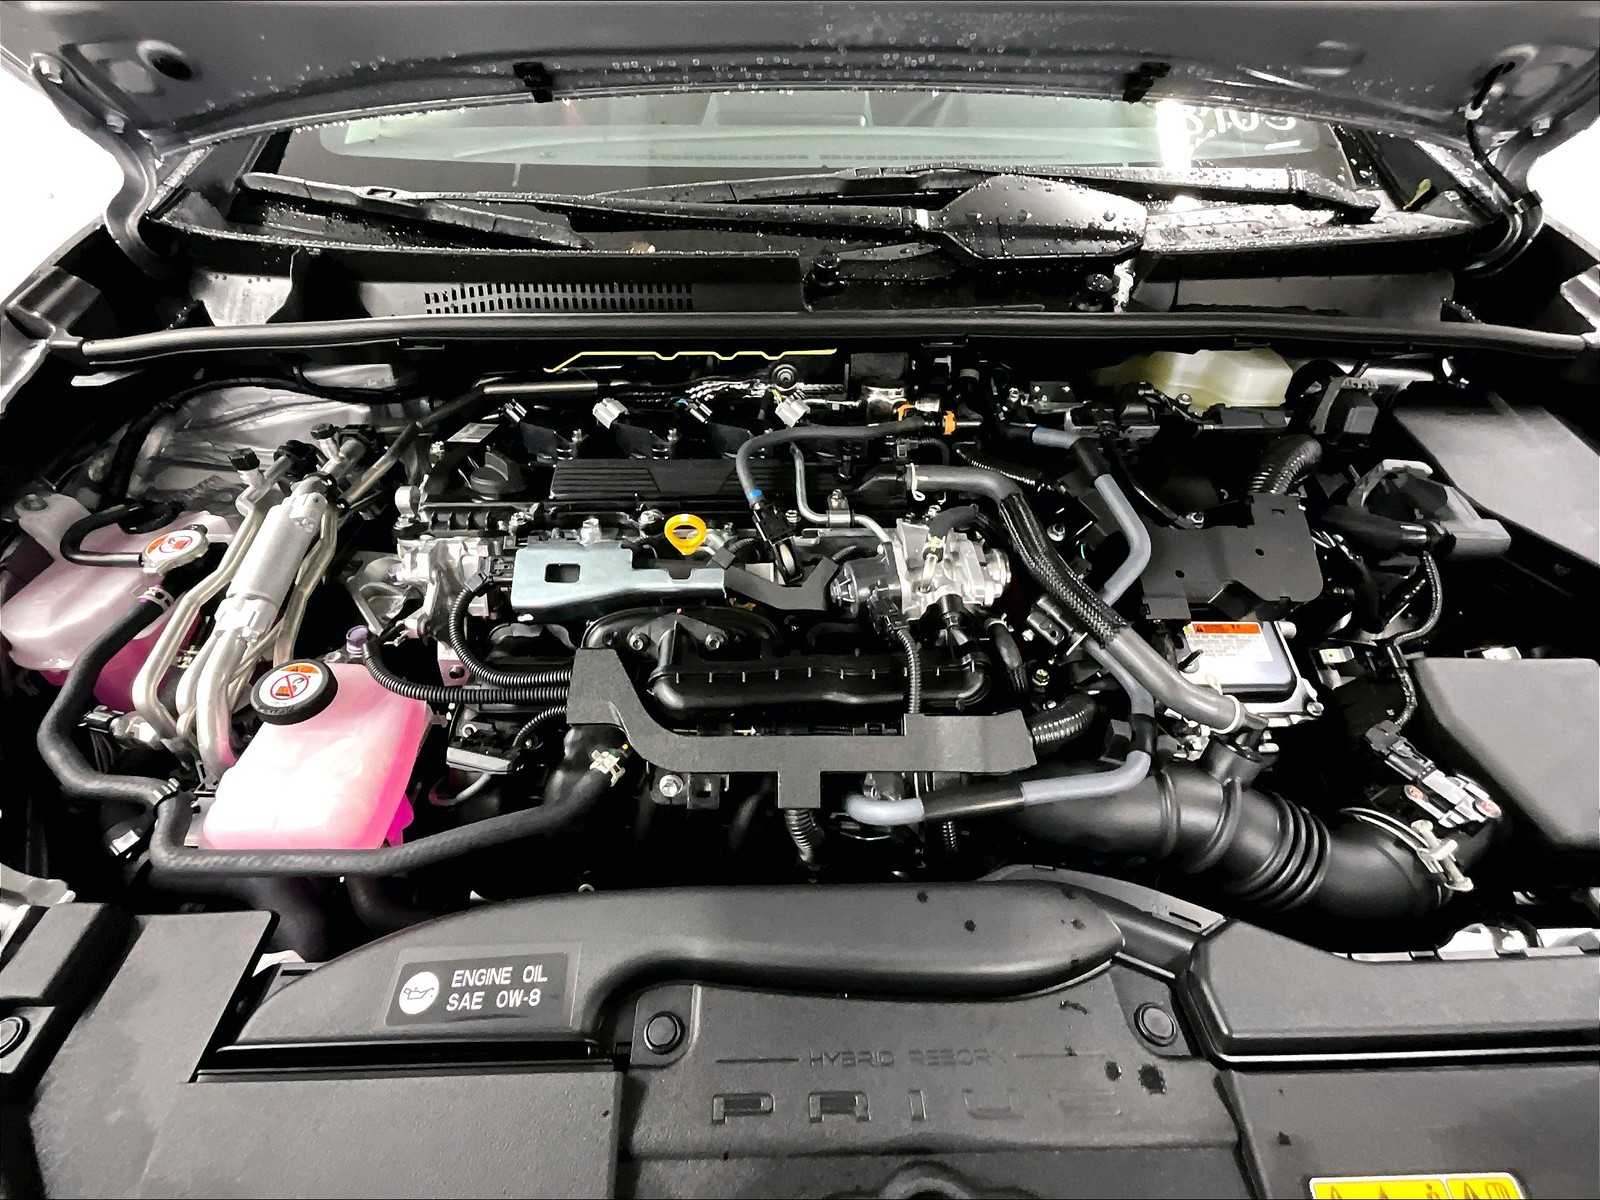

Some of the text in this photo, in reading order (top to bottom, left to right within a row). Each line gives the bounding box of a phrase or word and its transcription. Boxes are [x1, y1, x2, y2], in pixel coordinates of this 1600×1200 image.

[451, 964, 548, 988] ENGINE OIL
[446, 988, 541, 1011] SAE 0W-8
[808, 1049, 895, 1067] HYBRID
